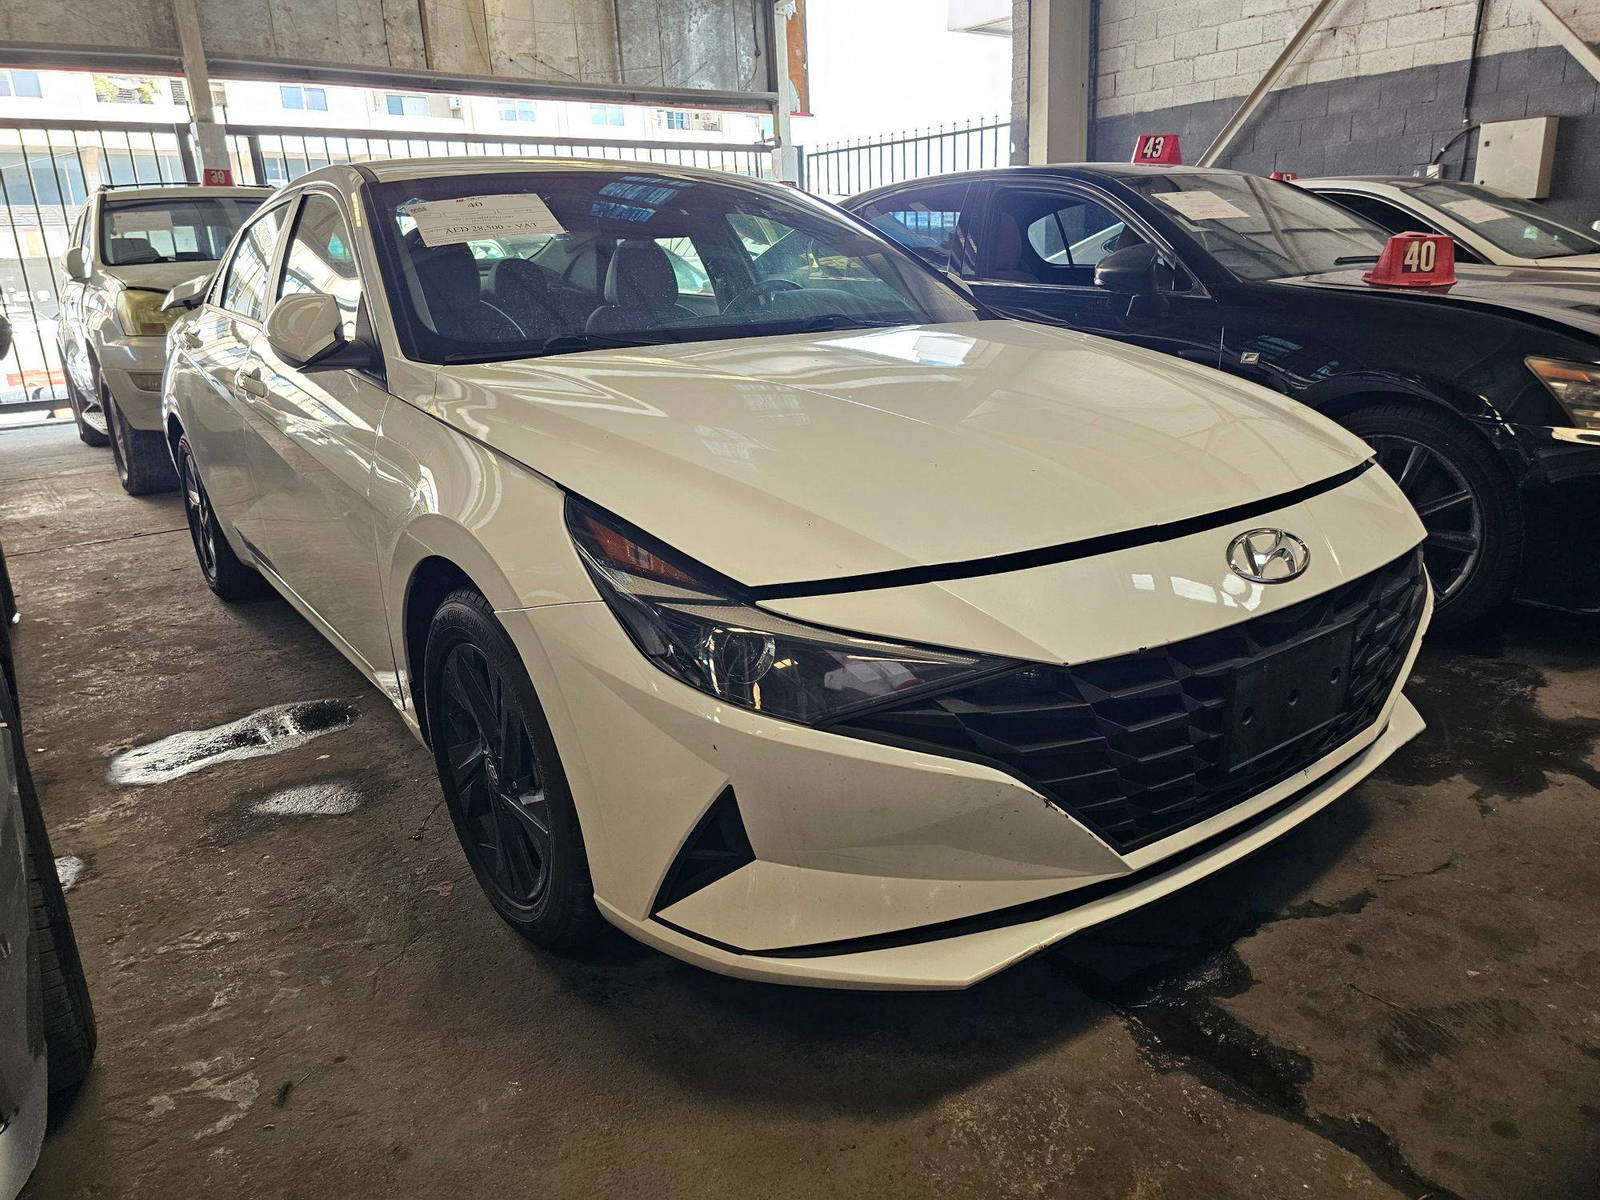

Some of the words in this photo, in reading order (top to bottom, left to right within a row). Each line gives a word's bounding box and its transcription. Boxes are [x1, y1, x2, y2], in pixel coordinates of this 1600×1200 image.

[1143, 136, 1164, 158] 43
[210, 170, 226, 184] 39
[468, 200, 483, 208] 40
[445, 225, 470, 235] AED
[515, 222, 537, 230] VAT
[1404, 240, 1436, 273] 40
